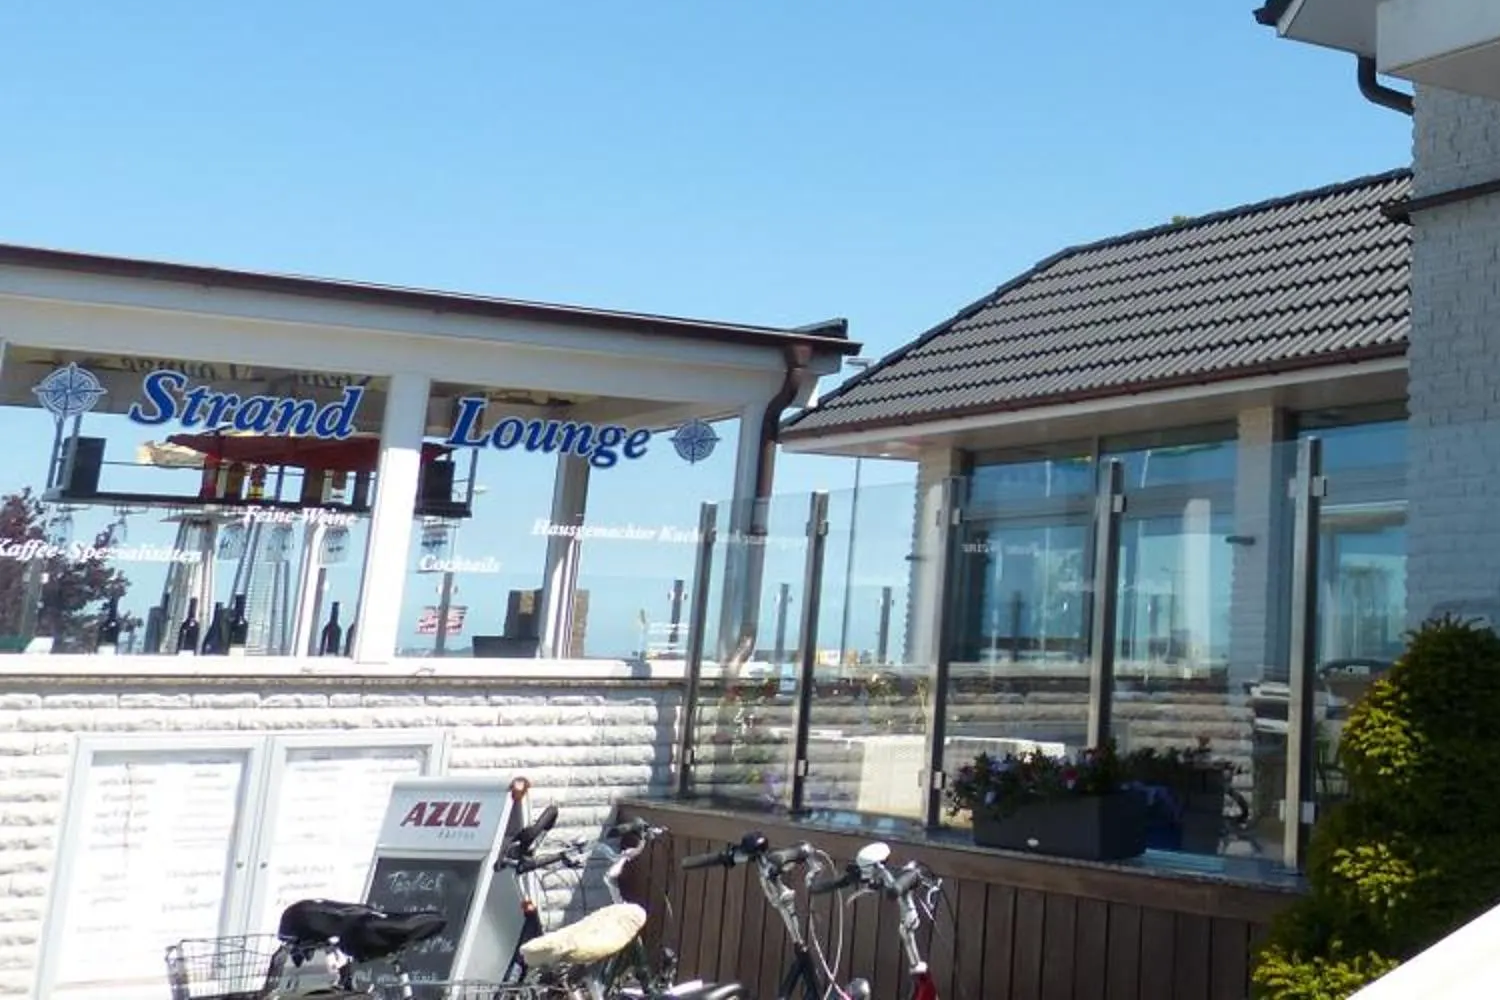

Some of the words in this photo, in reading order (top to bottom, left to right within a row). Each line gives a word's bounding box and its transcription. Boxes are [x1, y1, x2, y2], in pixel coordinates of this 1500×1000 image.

[129, 368, 365, 440] Strand
[446, 397, 652, 469] Lounge
[400, 802, 481, 827] AZUL
